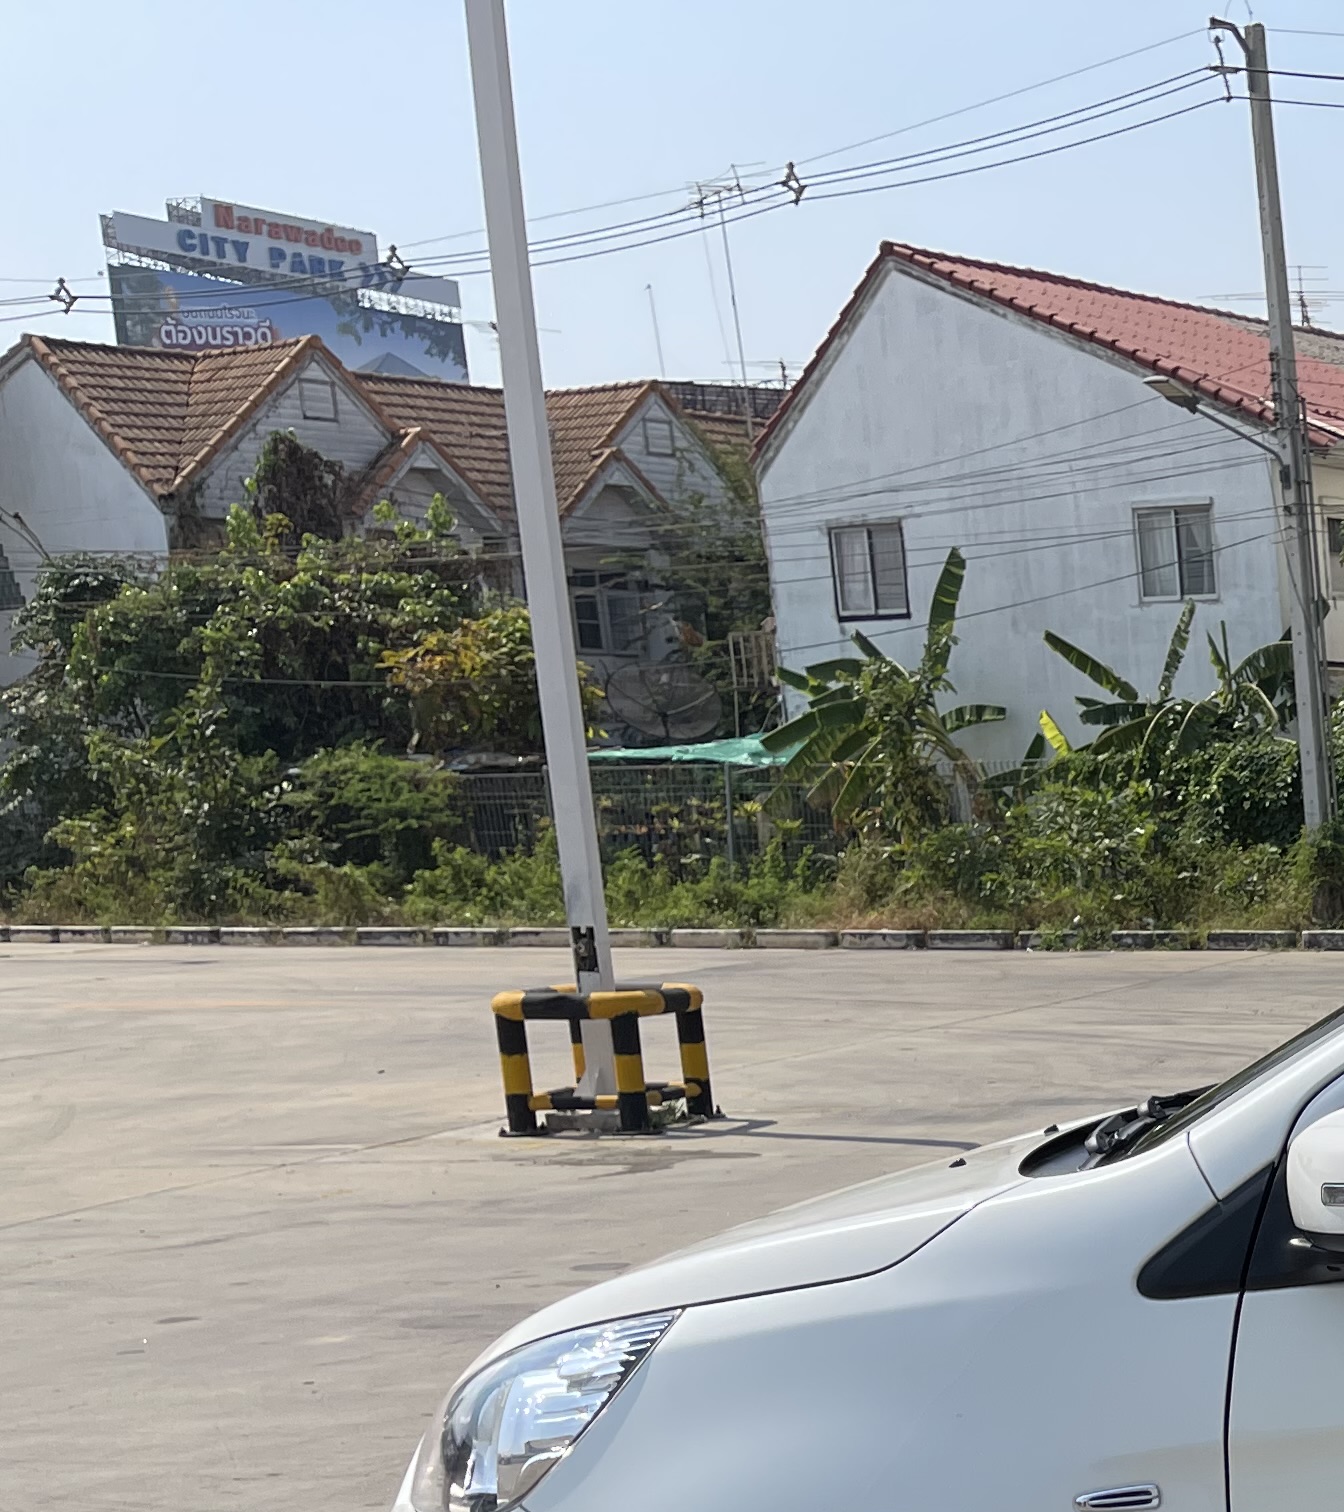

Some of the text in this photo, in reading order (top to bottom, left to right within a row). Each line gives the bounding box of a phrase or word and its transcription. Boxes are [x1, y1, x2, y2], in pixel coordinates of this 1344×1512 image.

[177, 229, 346, 281] CITY PARK
[160, 316, 273, 347] ต้องนราวดี
